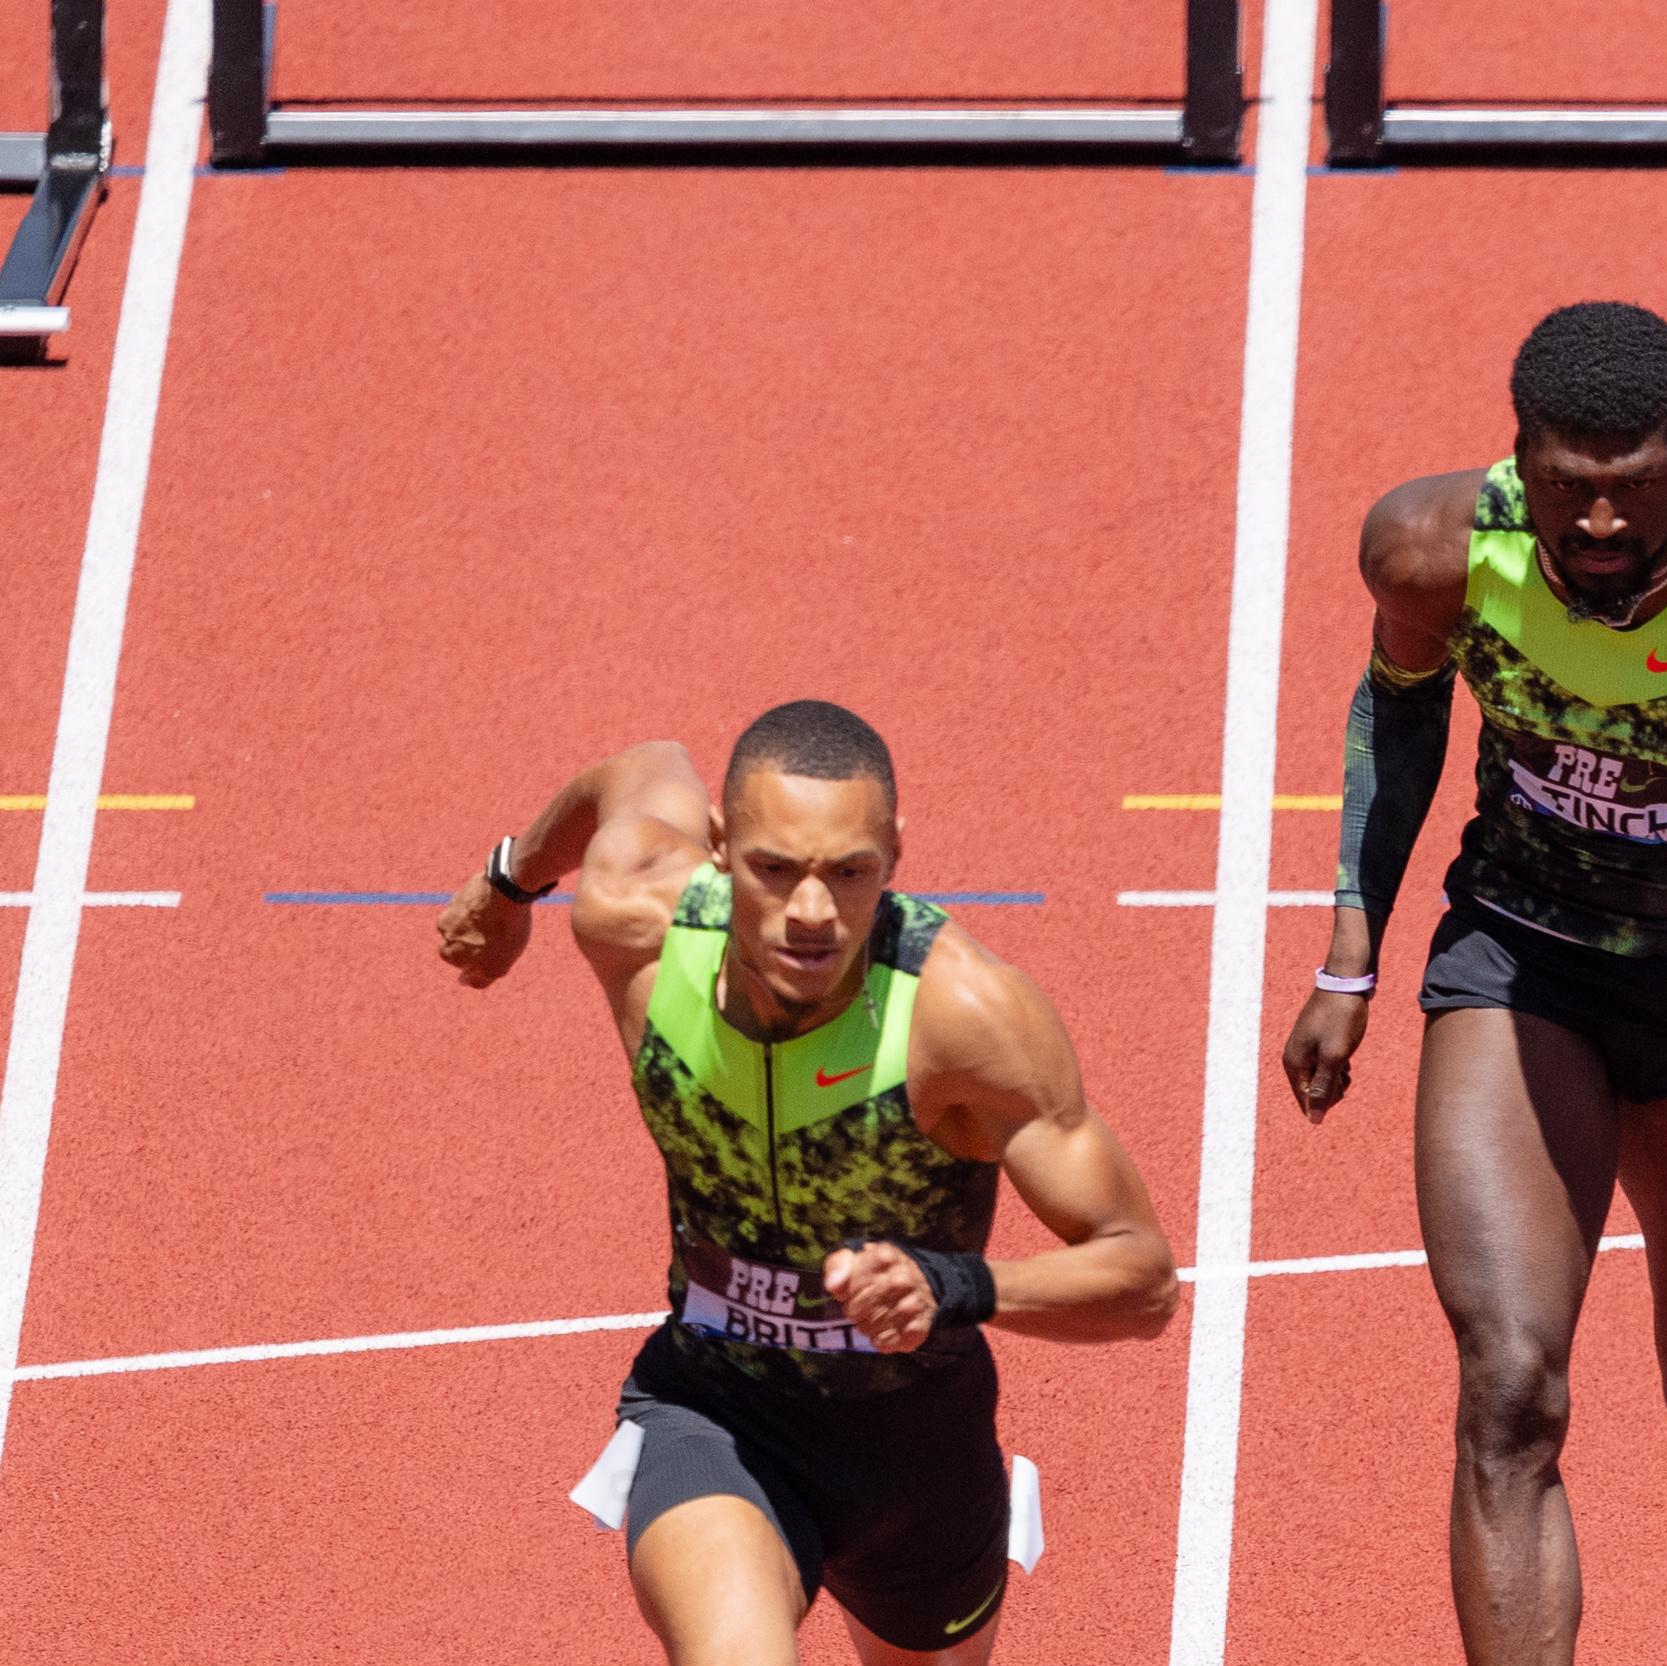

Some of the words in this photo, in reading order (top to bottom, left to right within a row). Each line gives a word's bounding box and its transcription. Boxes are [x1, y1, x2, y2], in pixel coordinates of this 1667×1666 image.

[1548, 744, 1624, 799] PRE
[726, 1257, 800, 1316] PRE
[725, 1304, 858, 1350] BRITT
